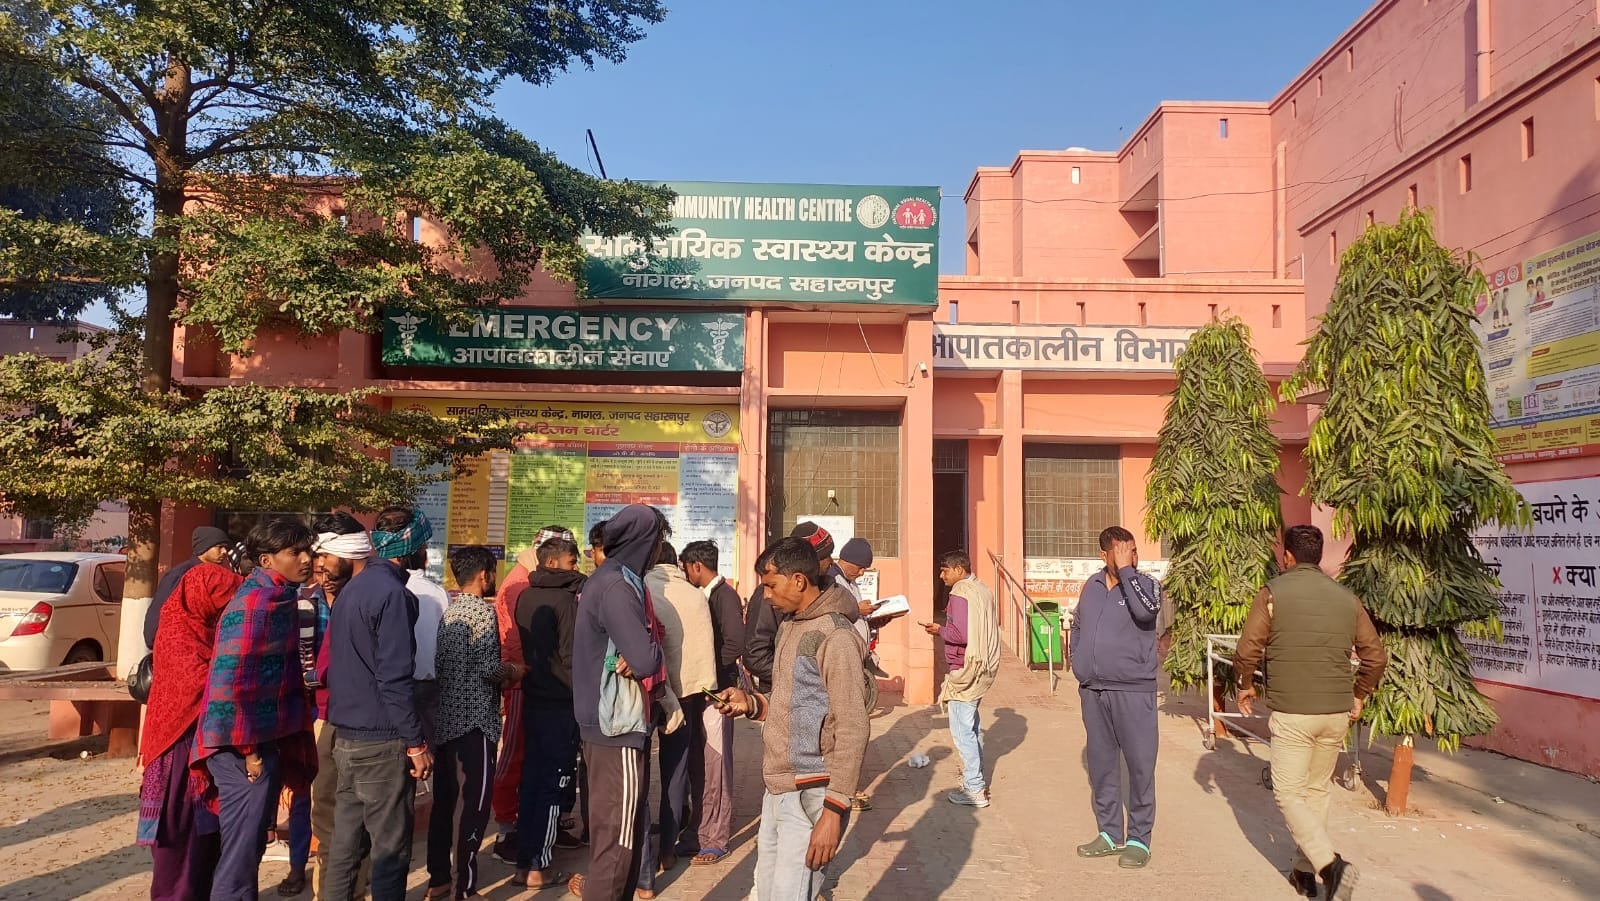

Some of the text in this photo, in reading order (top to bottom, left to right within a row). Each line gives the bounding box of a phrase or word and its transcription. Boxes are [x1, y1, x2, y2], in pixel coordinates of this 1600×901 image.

[671, 195, 852, 222] MMUNITY HEALTH CENTRE
[752, 238, 857, 263] स्वास्थ्य
[864, 232, 934, 269] केन्द्र
[707, 274, 784, 290] जनपद
[789, 276, 897, 300] सहारनपुर
[452, 345, 603, 367] आपातकालीन
[571, 410, 605, 421] नागल,
[609, 410, 641, 421] जनपद
[644, 411, 691, 426] सहारनपुर
[583, 423, 620, 437] चार्टर
[1531, 493, 1590, 524] बचने के
[1565, 565, 1597, 587] क्या
